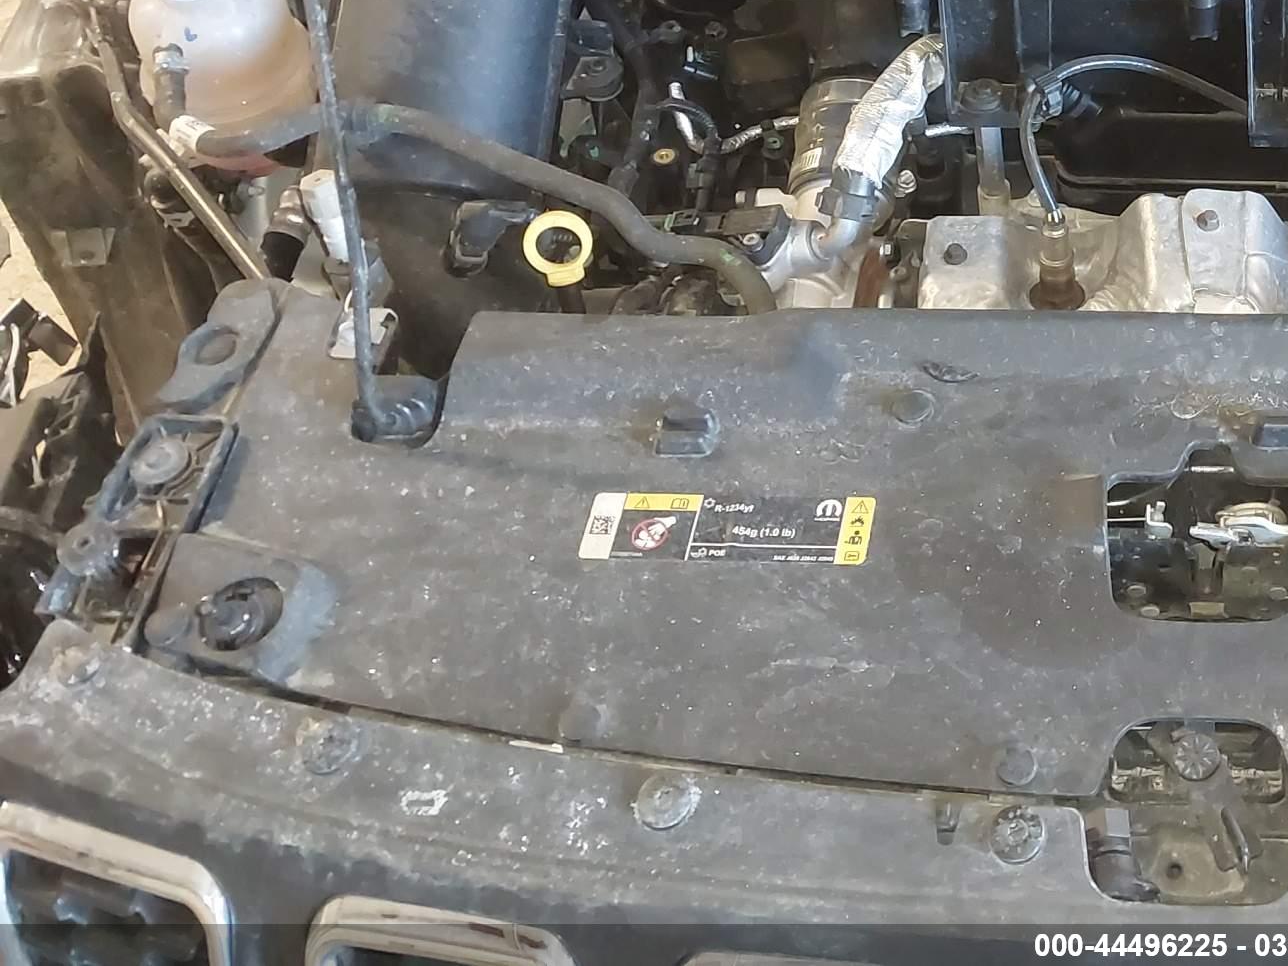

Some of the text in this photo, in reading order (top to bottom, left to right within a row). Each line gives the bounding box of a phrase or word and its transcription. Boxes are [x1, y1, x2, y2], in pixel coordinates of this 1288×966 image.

[714, 503, 755, 514] R-1234yf
[731, 525, 796, 539] 454g (1.0 lb)
[708, 548, 727, 556] POE
